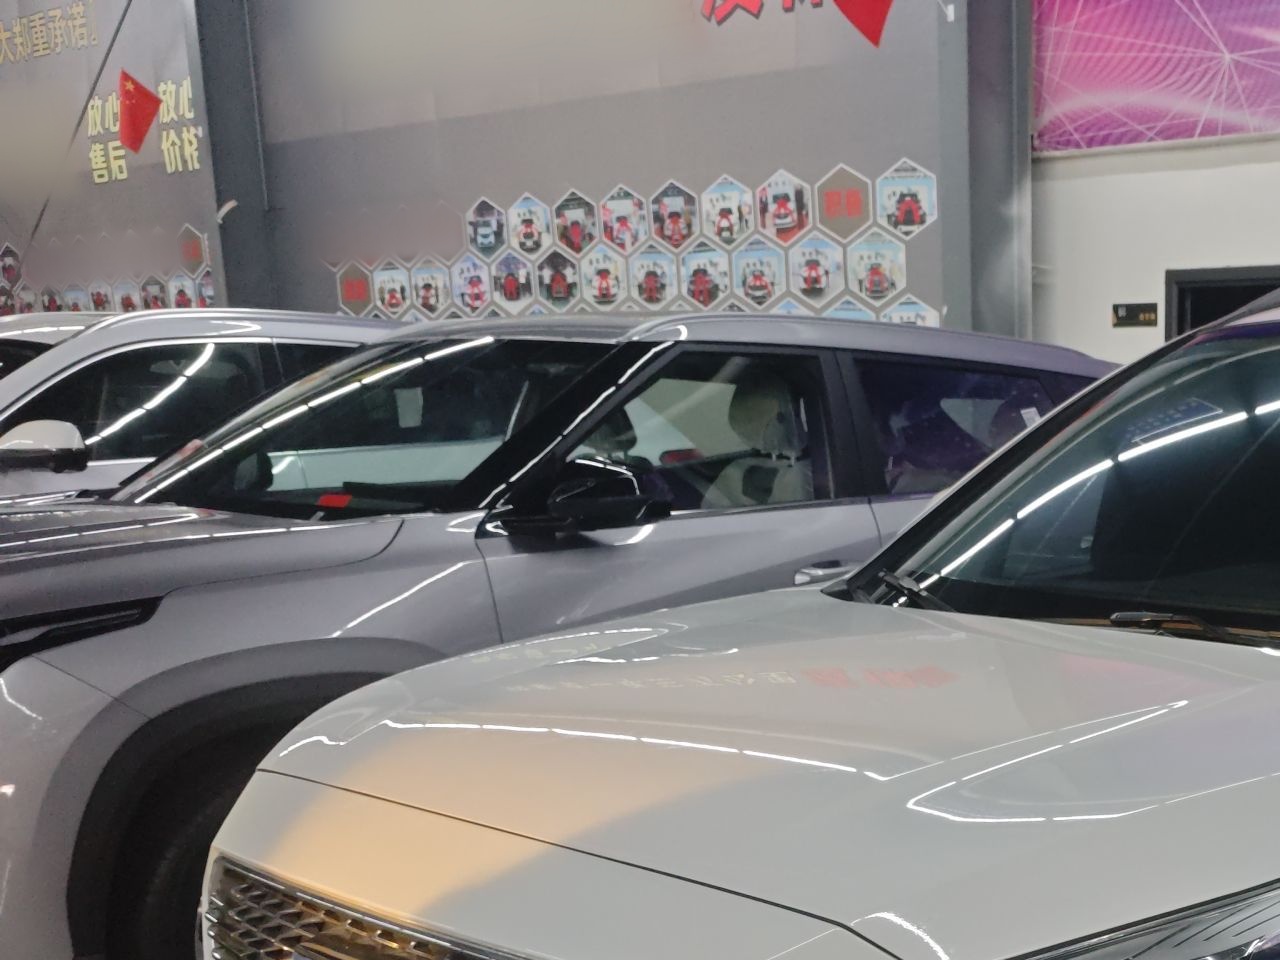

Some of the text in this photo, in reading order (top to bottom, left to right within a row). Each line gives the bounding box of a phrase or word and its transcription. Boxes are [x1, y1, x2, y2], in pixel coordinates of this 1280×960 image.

[88, 92, 120, 137] 放心
[158, 76, 194, 124] 放心
[89, 140, 128, 184] 售后
[162, 126, 200, 174] 价格
